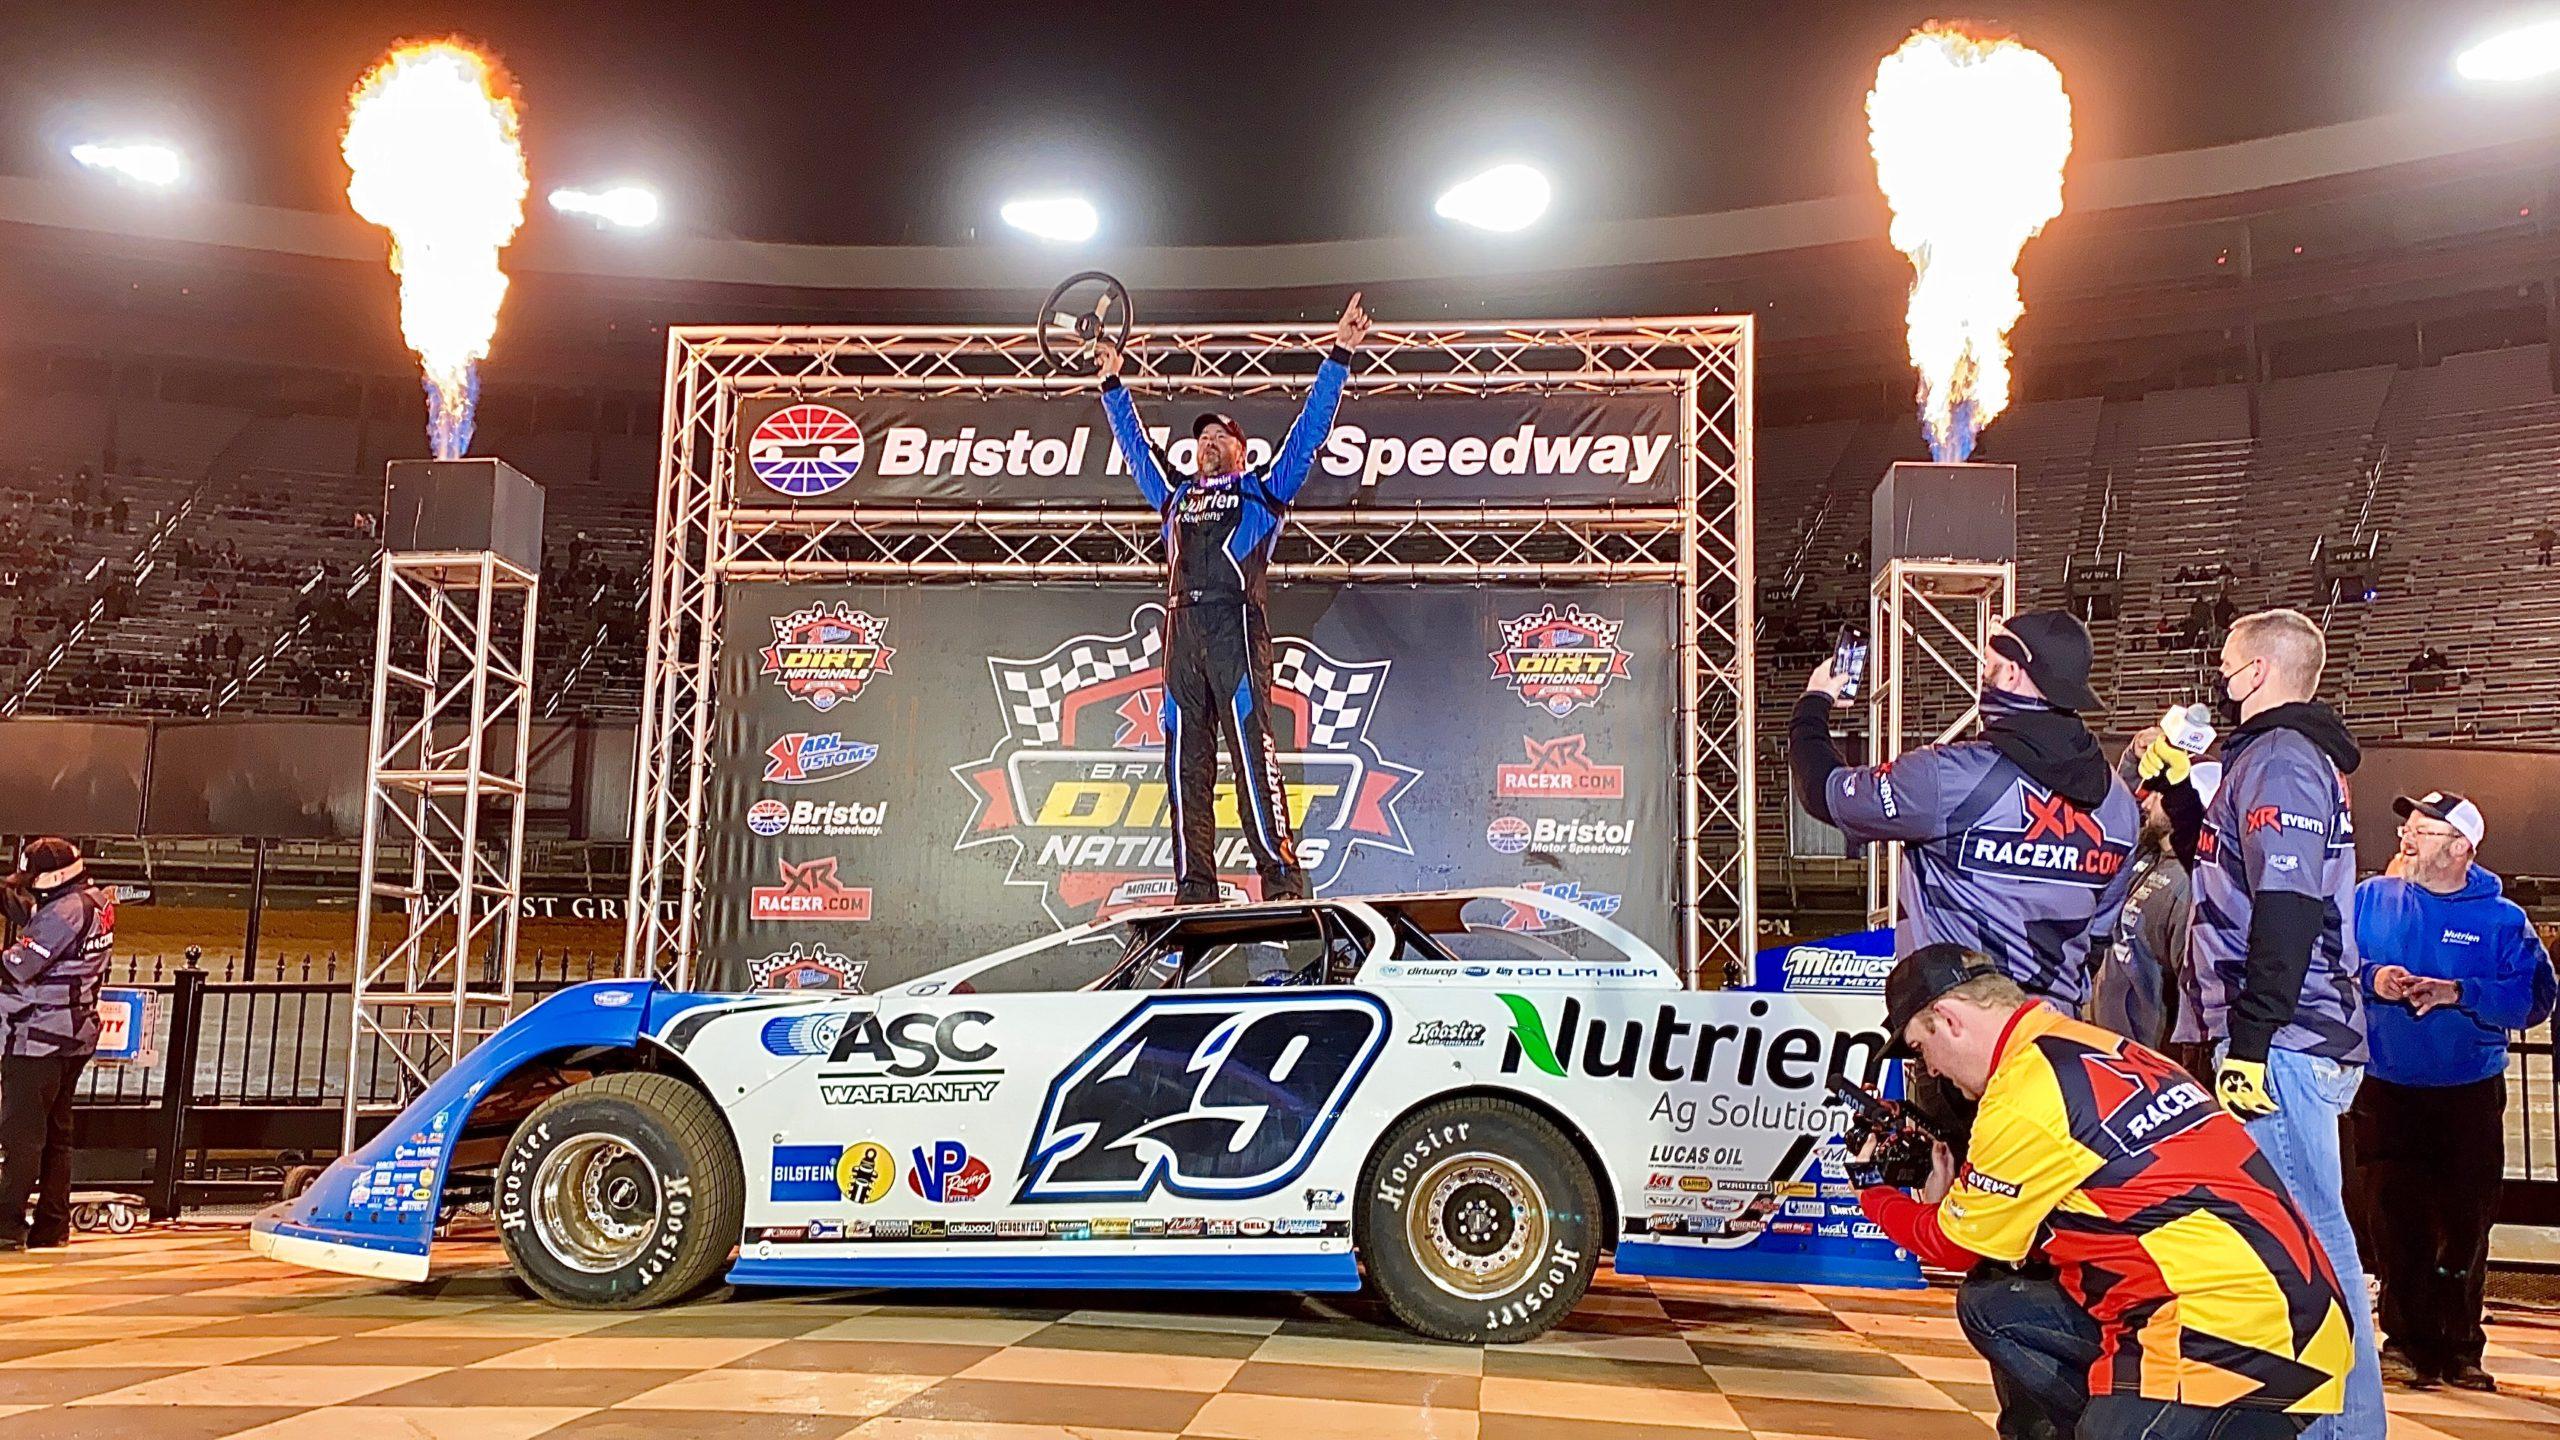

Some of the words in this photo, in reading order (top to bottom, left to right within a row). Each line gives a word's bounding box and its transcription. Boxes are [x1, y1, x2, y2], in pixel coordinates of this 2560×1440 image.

[877, 426, 1091, 477] Bristol
[1320, 424, 1672, 486] Speedway
[784, 652, 872, 669] DIRT
[1515, 657, 1609, 673] DIRT
[783, 668, 869, 680] NATIONALS
[1516, 673, 1606, 684] NATIONALS
[1505, 773, 1615, 790] RACEXR.COM
[790, 800, 888, 825] Bristol
[2281, 812, 2324, 835] EVENTS
[788, 824, 822, 835] Motor
[823, 825, 881, 837] Speedway
[1533, 818, 1635, 844] Bristol
[1530, 843, 1566, 853] Motor
[1568, 843, 1630, 856] Speedway
[758, 896, 863, 911] RACEXR.COM
[1518, 967, 1551, 977] GO
[1558, 967, 1658, 978] LITHIUM
[1790, 977, 1841, 986] SHEET
[1843, 978, 1886, 987] META
[1408, 1020, 1487, 1043] Hoosier
[1496, 993, 1889, 1091] Nutrien
[826, 1010, 998, 1078] ASC
[820, 1080, 1001, 1105] WARRANTY
[1028, 998, 1384, 1194] 49
[1649, 1091, 1698, 1133] Ag
[1707, 1094, 1850, 1134] Solution
[1650, 1144, 1710, 1164] LUCAS
[1713, 1147, 1743, 1165] OIL
[500, 1122, 551, 1233] Hoosier
[774, 1164, 835, 1182] BILSTEIN
[911, 1140, 967, 1203] VP
[1377, 1121, 1470, 1212] Hoosier
[946, 1172, 991, 1194] Racing
[638, 1174, 692, 1286] Hoosier
[1486, 1239, 1582, 1330] Hoosier
